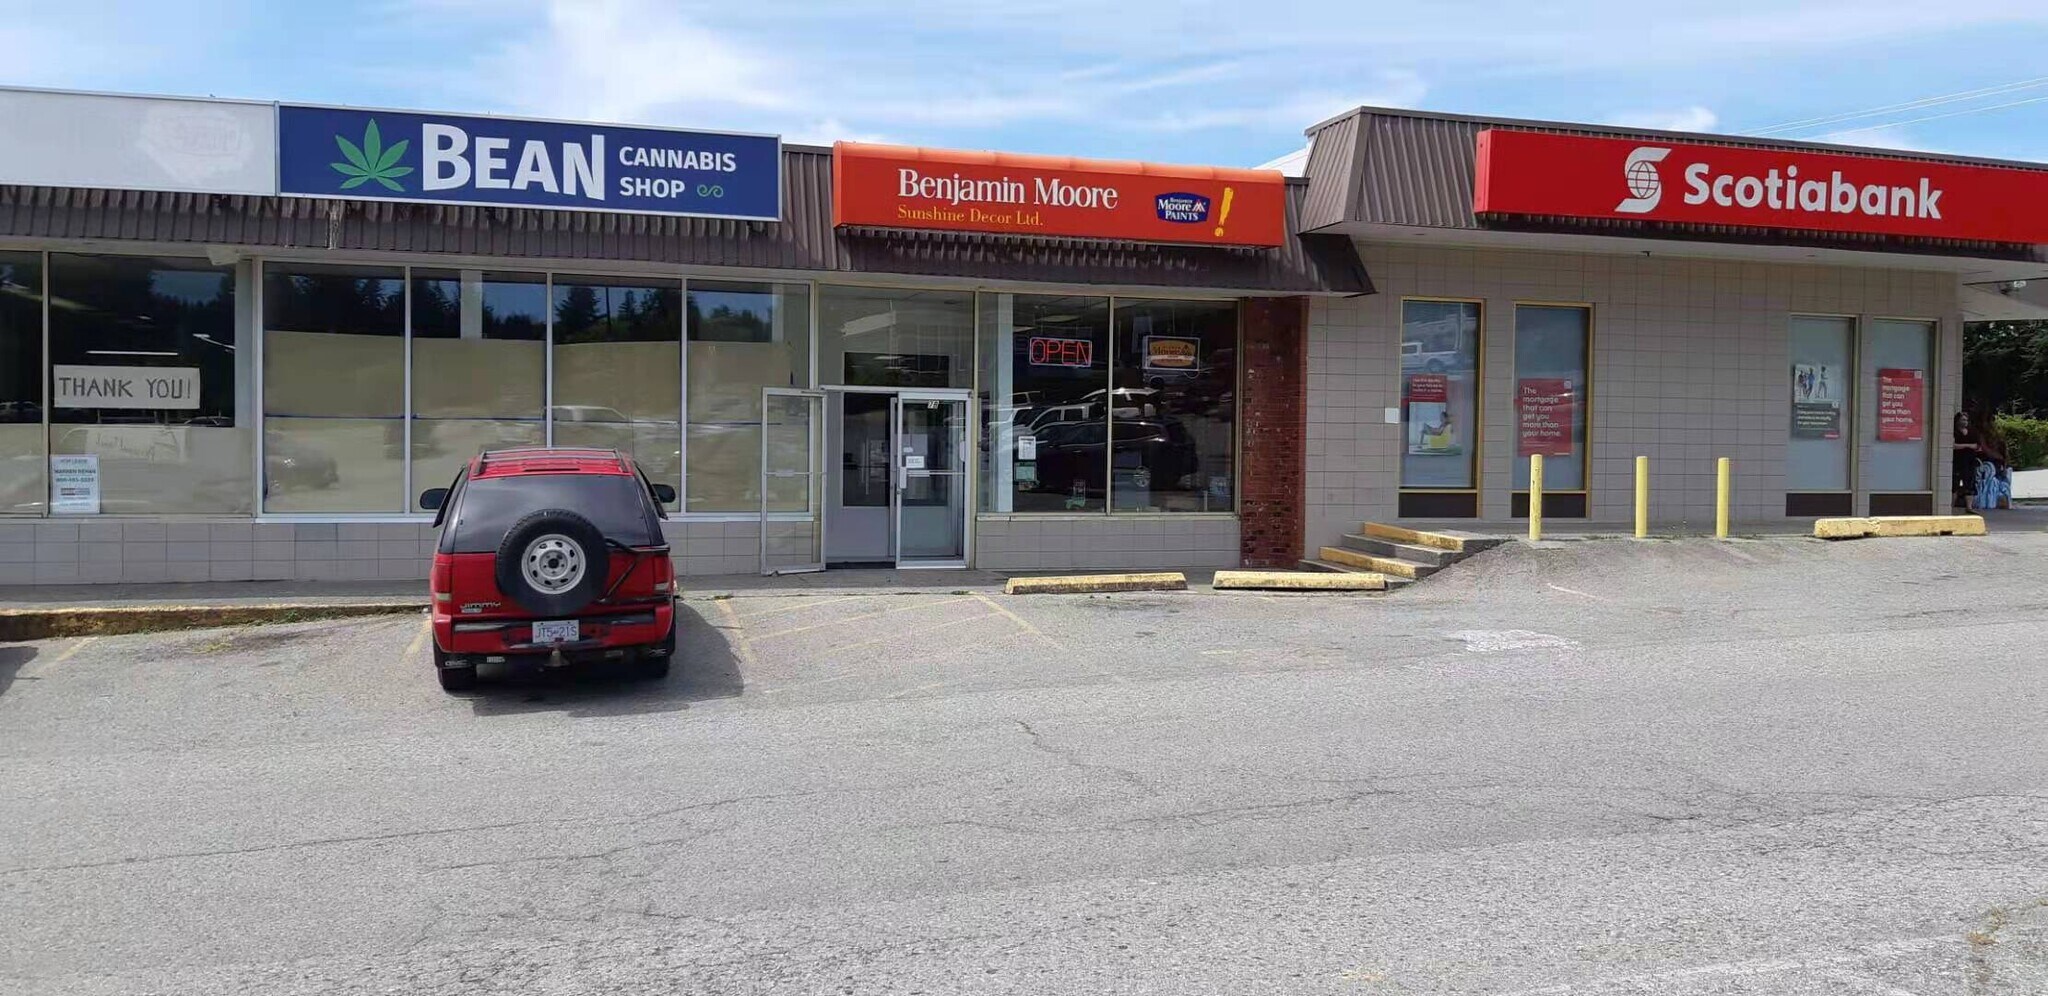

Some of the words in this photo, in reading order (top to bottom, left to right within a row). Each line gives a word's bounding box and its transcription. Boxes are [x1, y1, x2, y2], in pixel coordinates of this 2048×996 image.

[423, 123, 605, 200] BEAN
[619, 146, 736, 172] CANNABIS
[619, 177, 685, 198] SHOP
[898, 168, 1025, 206] Benjamin
[1033, 177, 1118, 209] Moore
[1684, 163, 1943, 219] Scotiabank
[898, 204, 965, 222] Sunshine
[970, 208, 1011, 224] Decor
[1016, 210, 1044, 226] Ltd.
[1158, 198, 1192, 211] Moore
[1165, 210, 1199, 220] PAINTS
[1031, 339, 1091, 366] OPEN
[58, 377, 133, 398] THANK
[146, 377, 191, 399] YOU!
[1522, 396, 1559, 404] mortgage
[1536, 413, 1549, 421] you
[1522, 430, 1539, 438] your
